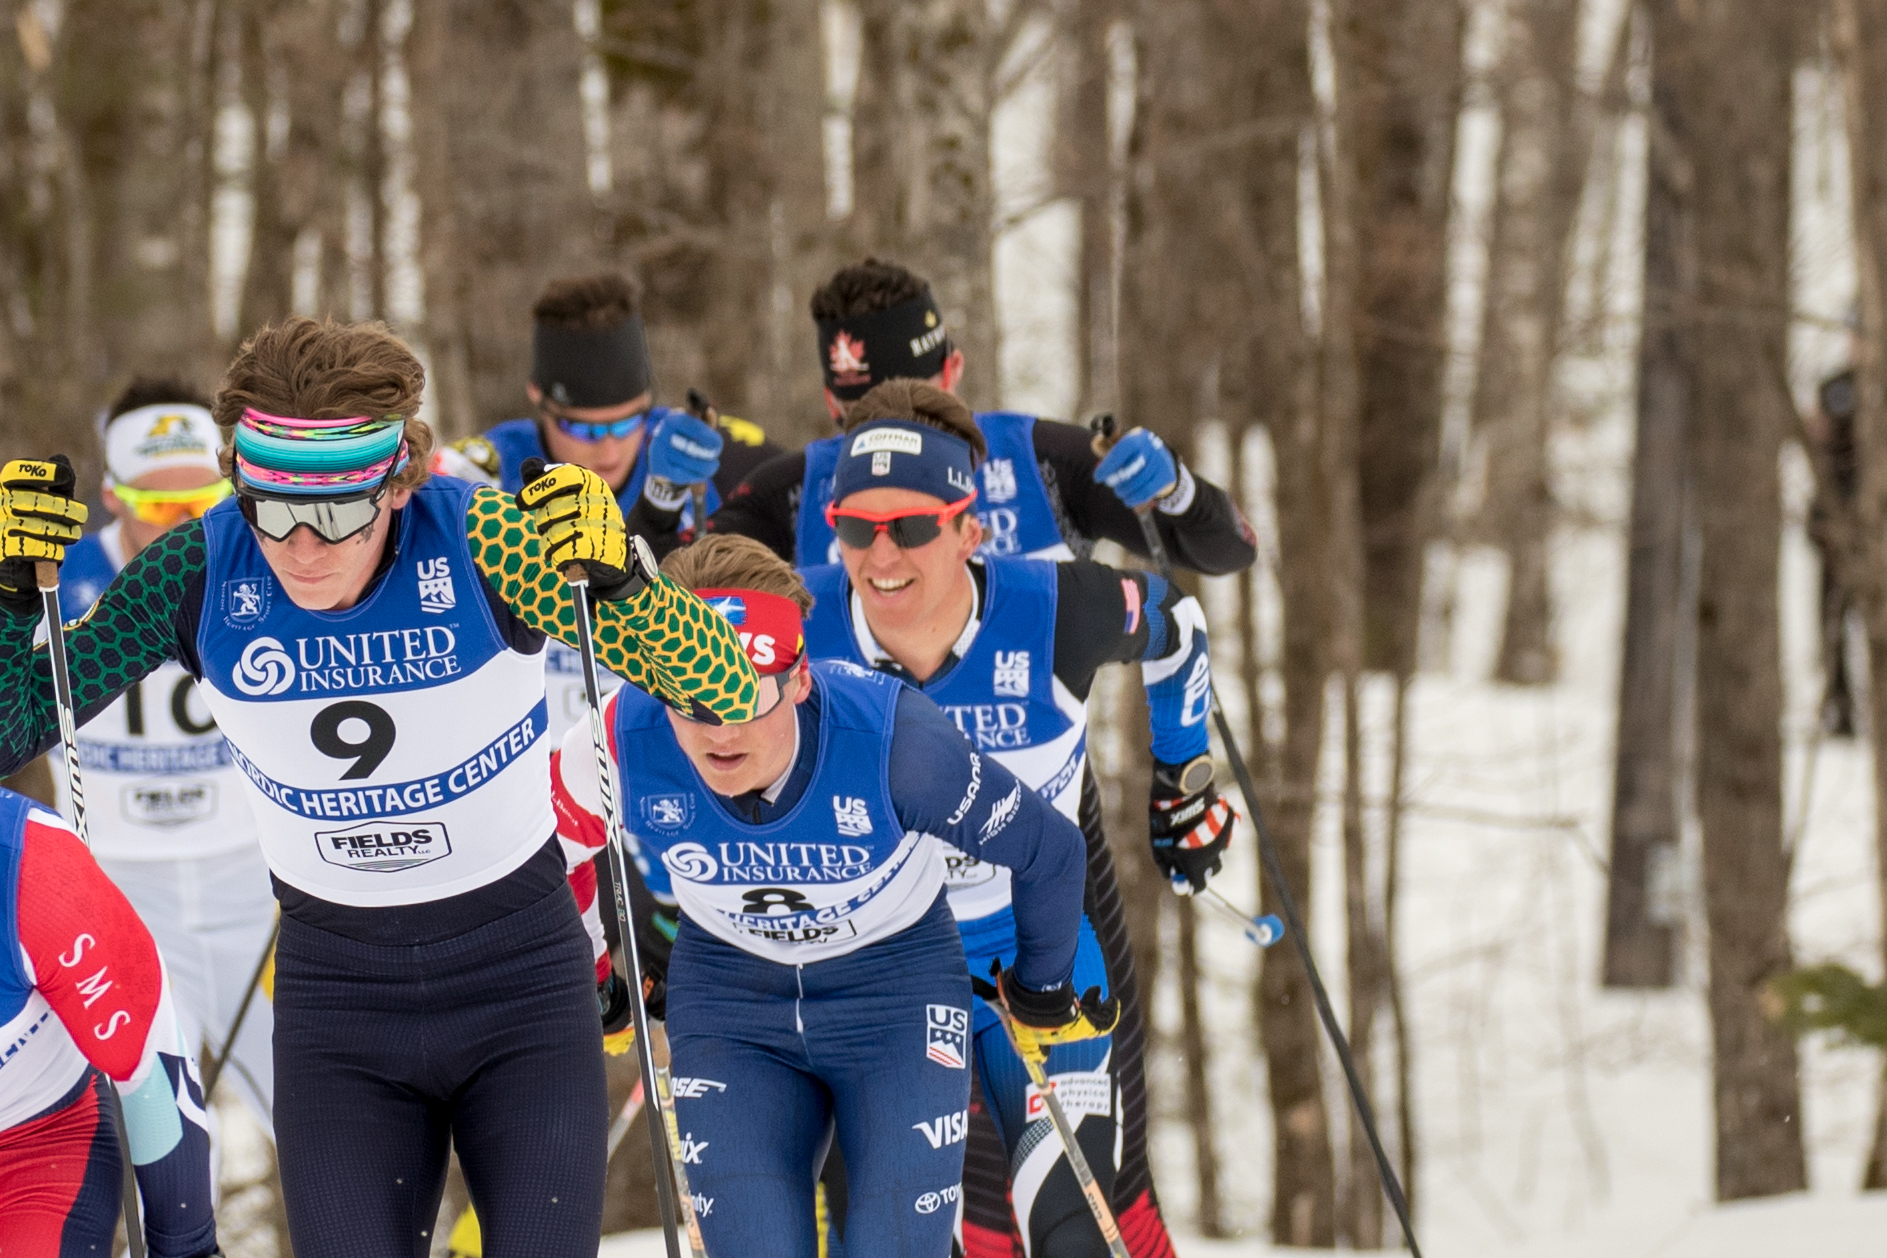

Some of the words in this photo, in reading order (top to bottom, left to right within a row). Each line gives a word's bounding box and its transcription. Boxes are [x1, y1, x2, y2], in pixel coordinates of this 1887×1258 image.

[416, 557, 451, 580] US
[296, 625, 457, 670] UNITED
[994, 650, 1030, 669] US
[299, 655, 462, 693] INSURANCE
[945, 702, 1027, 731] TED
[310, 699, 397, 781] 9
[227, 739, 299, 812] NORDIC
[300, 777, 444, 817] HERITAGE
[448, 717, 536, 794] CENTER
[832, 795, 868, 815] US
[331, 829, 433, 850] FIELDS
[347, 845, 419, 859] REALTY
[718, 842, 870, 867] UNITED
[722, 862, 875, 882] INSURANCE
[741, 887, 815, 915] 8
[929, 1006, 966, 1032] US
[912, 1109, 969, 1149] VISA
